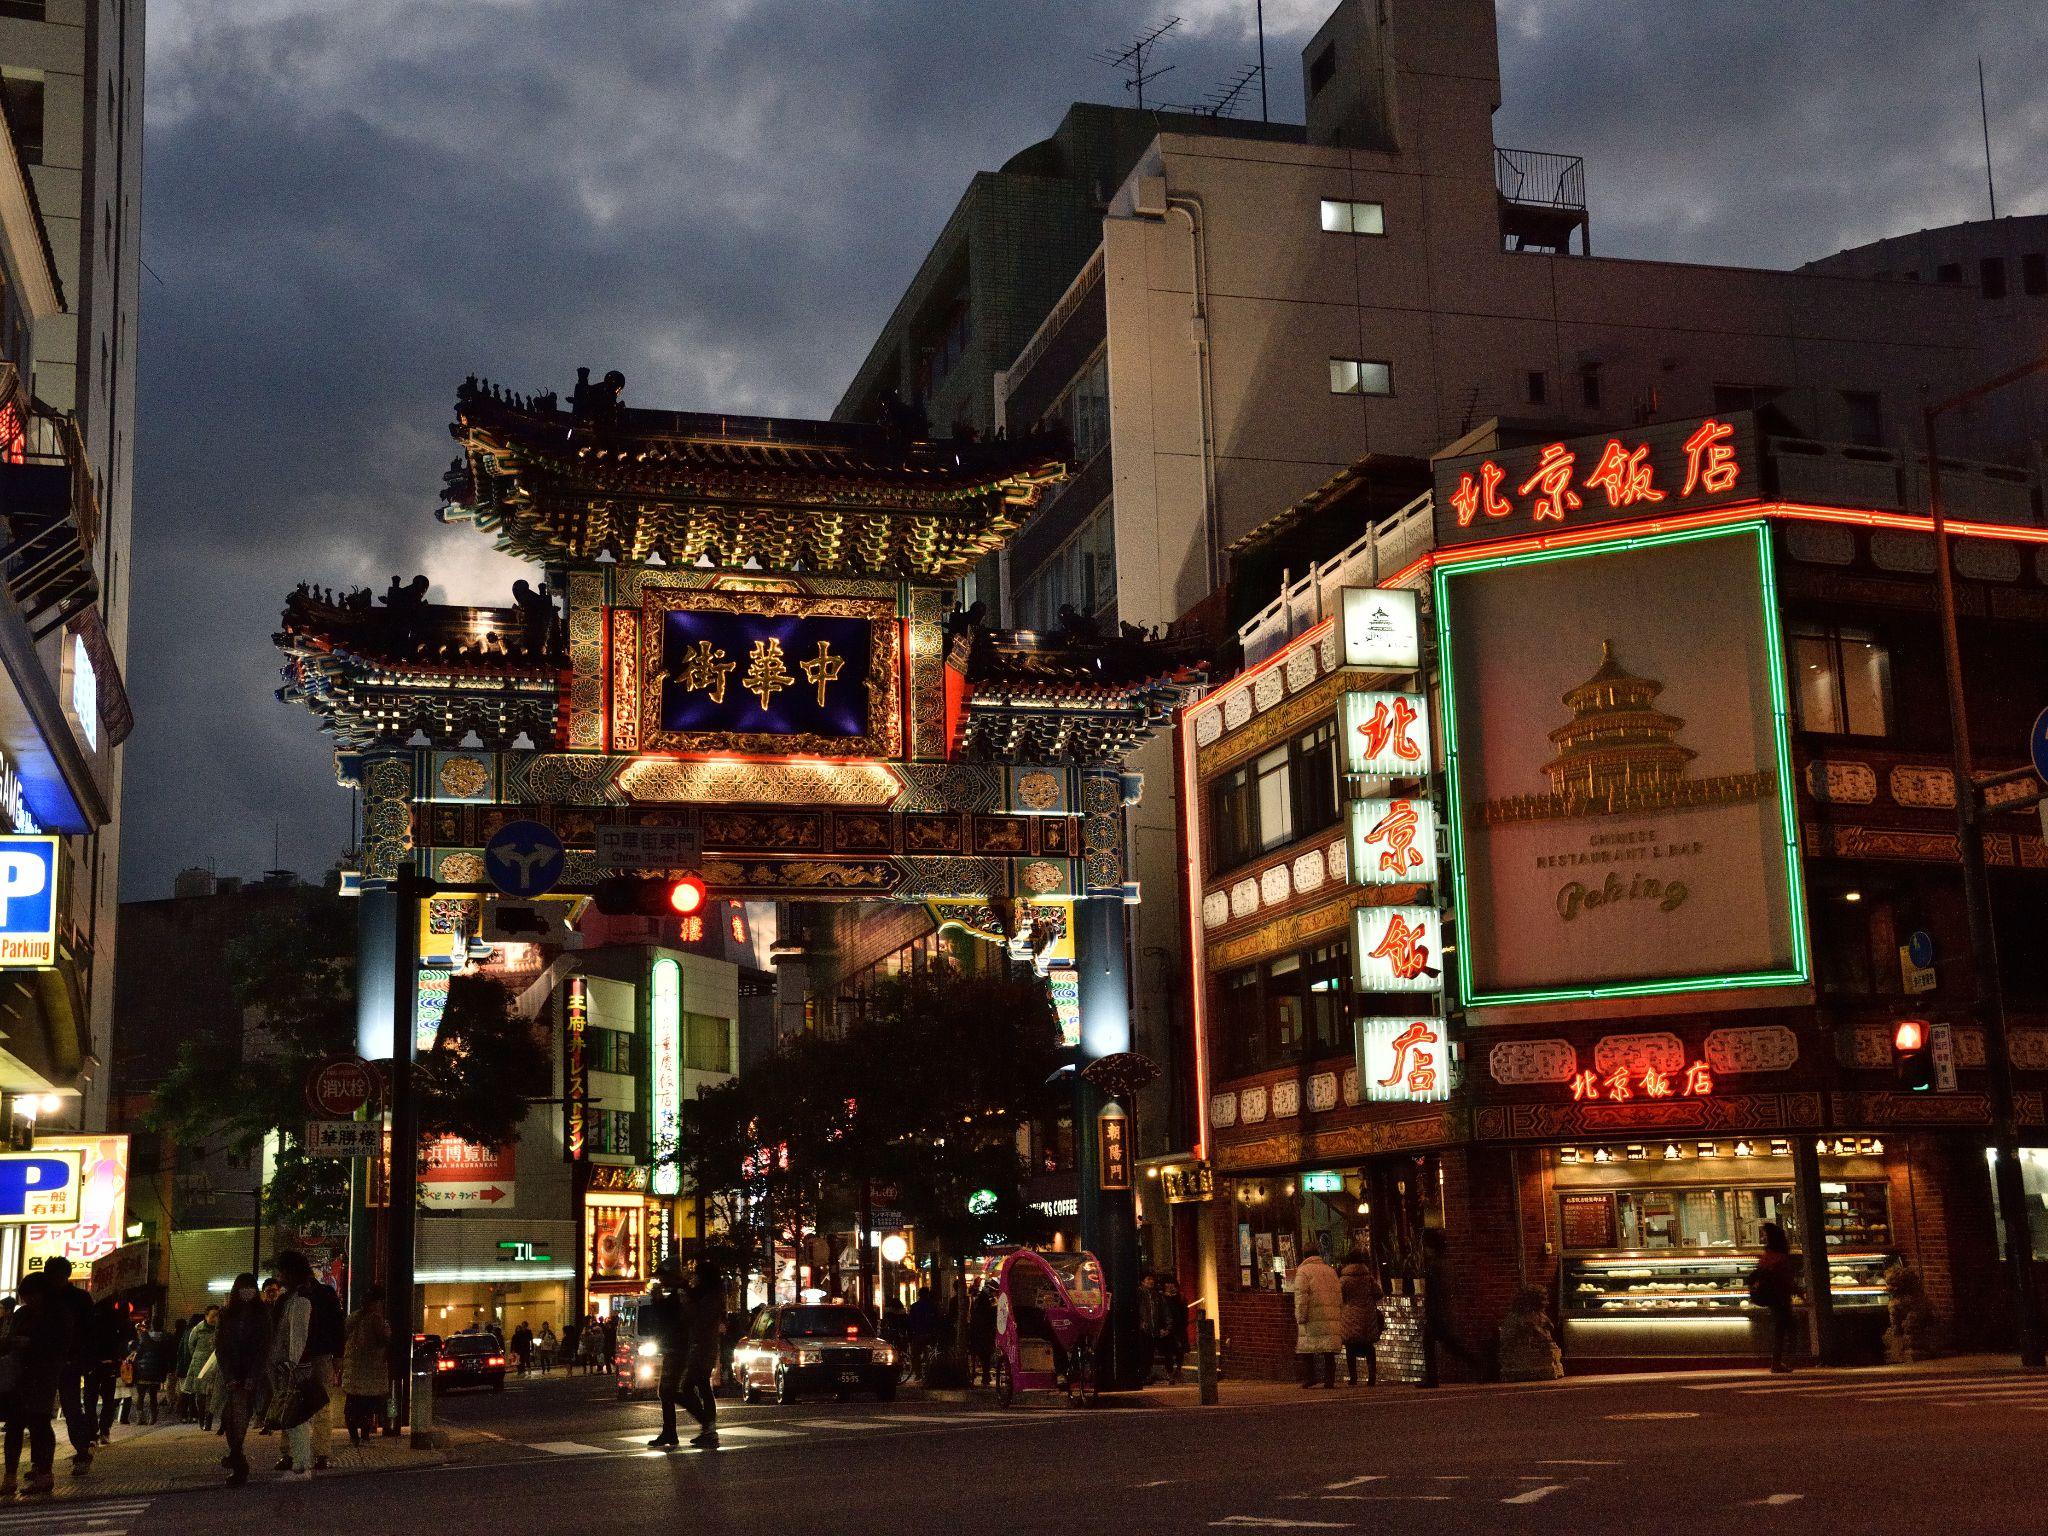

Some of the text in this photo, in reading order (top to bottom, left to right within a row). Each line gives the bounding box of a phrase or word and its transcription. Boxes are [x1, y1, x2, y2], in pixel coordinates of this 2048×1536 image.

[1449, 418, 1738, 525] 北京飯店
[674, 637, 845, 711] 中華街
[603, 832, 695, 851] 中華街東門
[1590, 830, 1656, 846] CHINESE
[612, 852, 641, 863] China
[646, 853, 674, 863] Town
[1537, 847, 1646, 868] RESTAURANT
[0, 851, 46, 927] P
[1357, 697, 1441, 1092] 北京飯店
[1557, 871, 1689, 921] Peking
[2, 939, 50, 960] Parking
[568, 995, 587, 1152] 王府井レストラン
[1570, 1060, 1714, 1102] 北京飯店
[322, 1080, 366, 1098] 消火栓
[1107, 1123, 1122, 1180] 朝陽門
[0, 1159, 70, 1215] P
[32, 1192, 66, 1201] 一般
[32, 1204, 66, 1215] 有料
[1053, 1199, 1078, 1216] COFFEE
[30, 1224, 100, 1241] チャイナ
